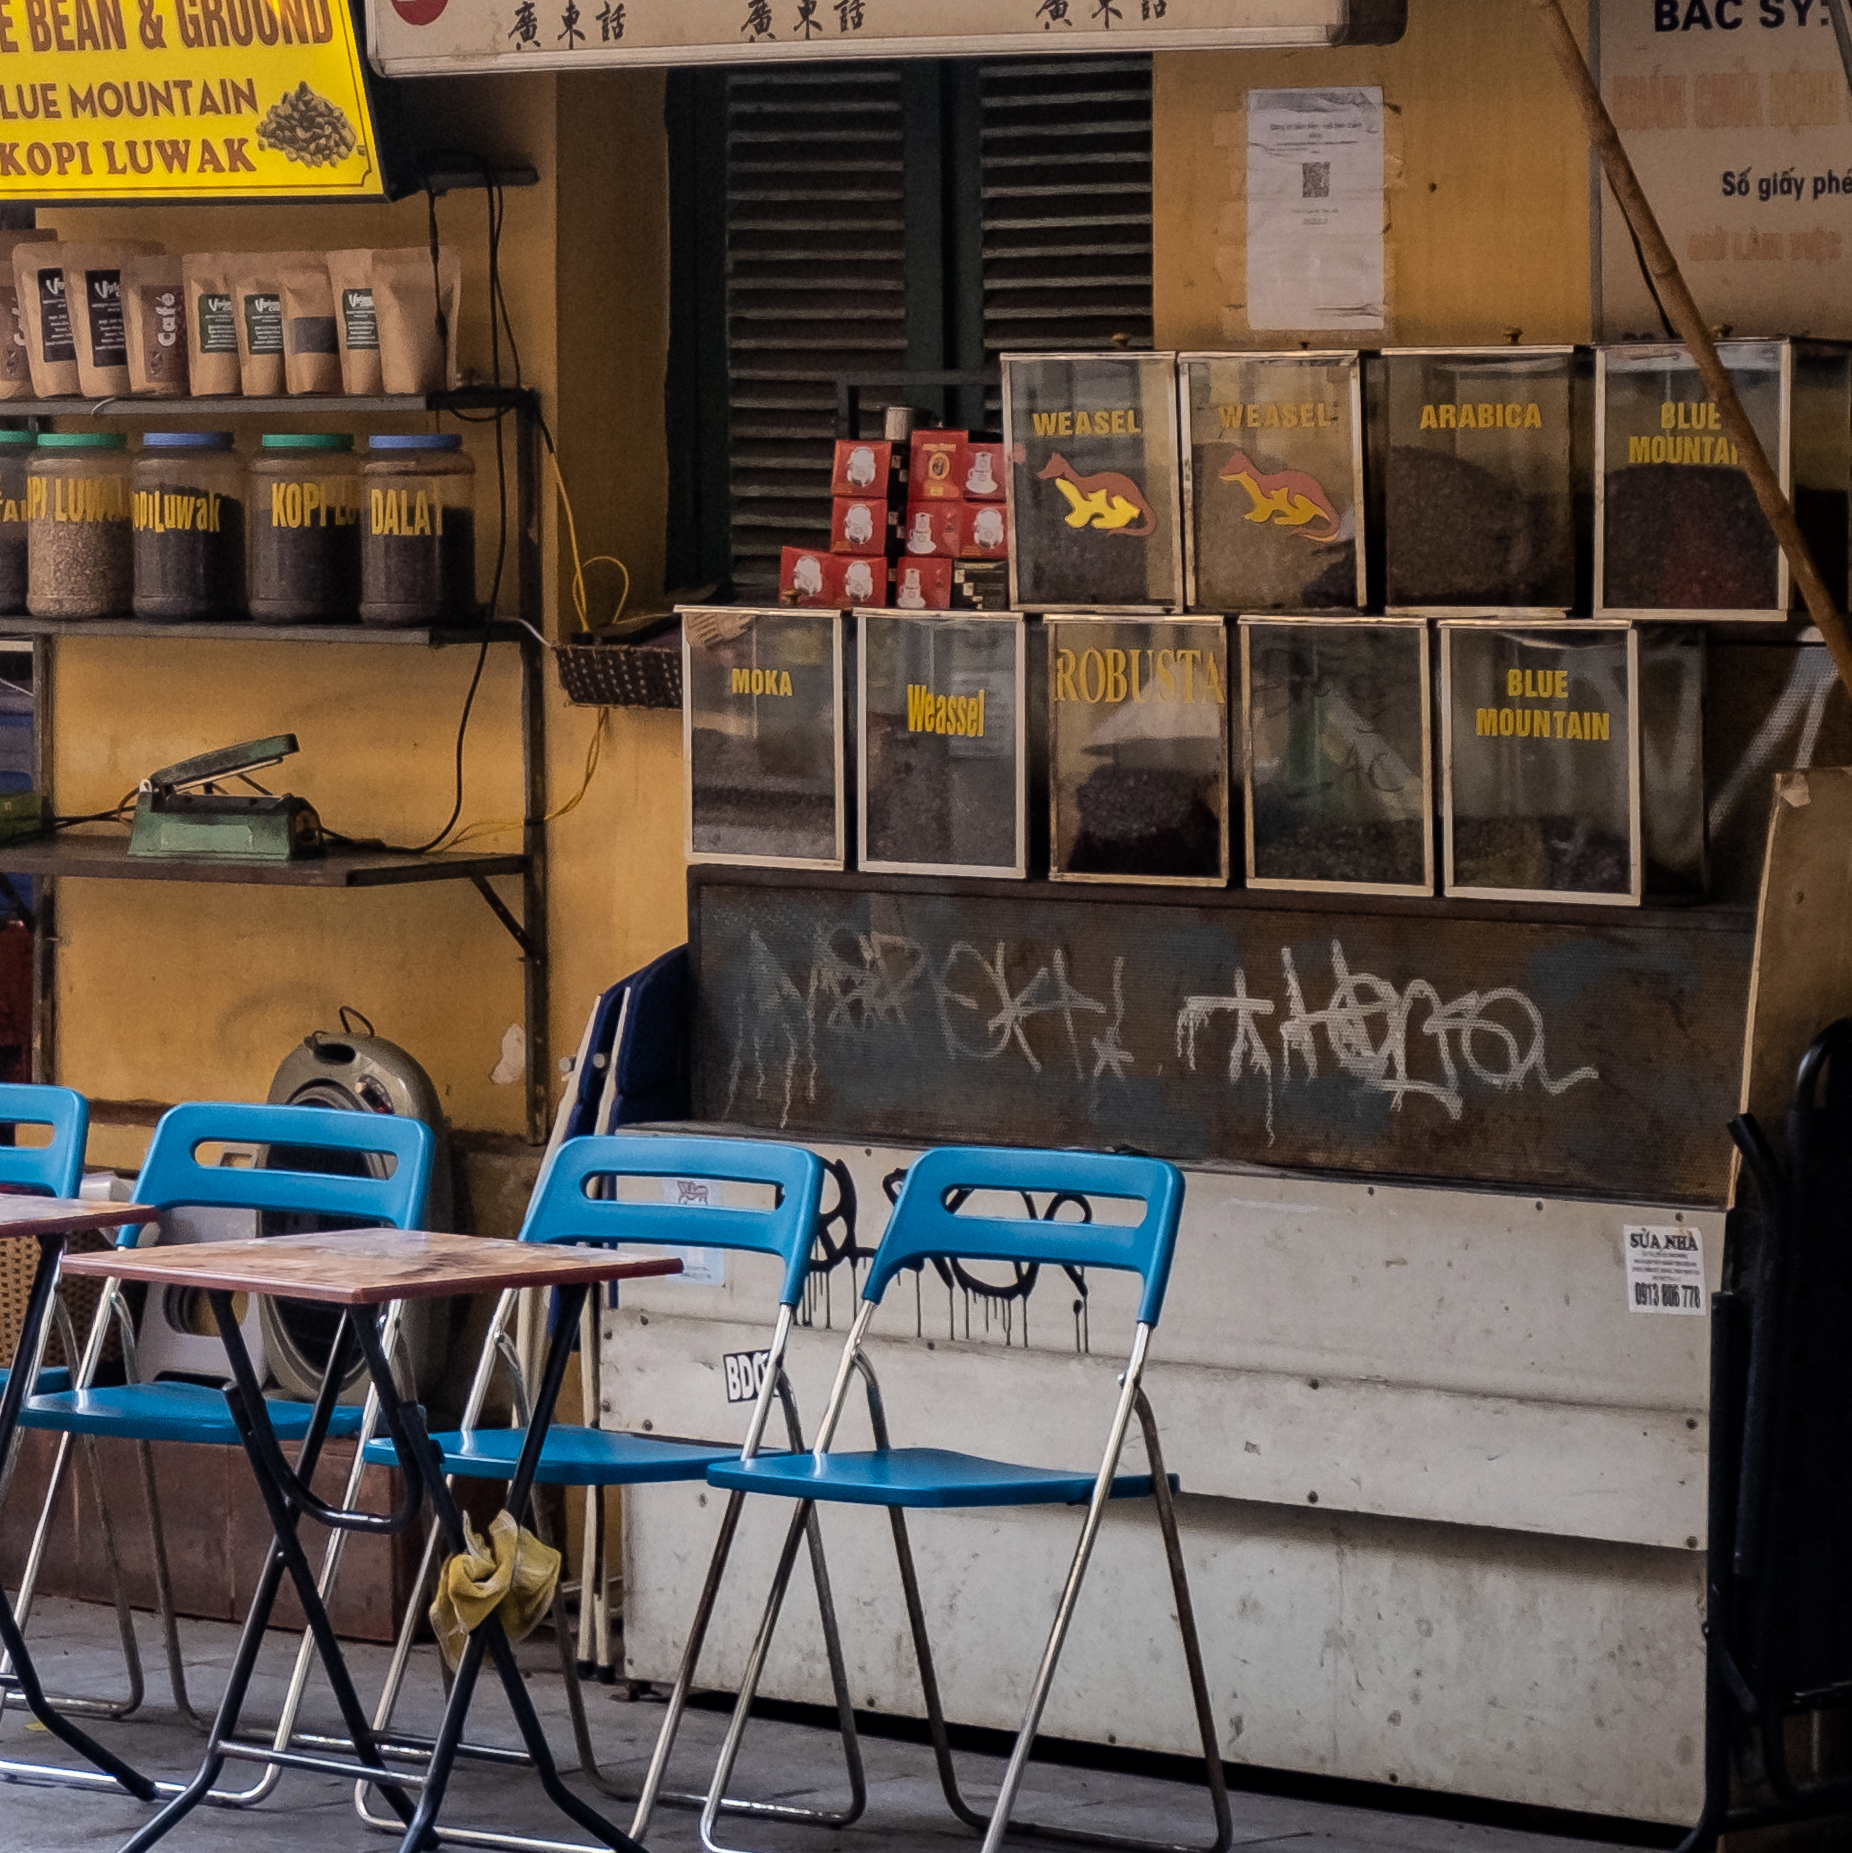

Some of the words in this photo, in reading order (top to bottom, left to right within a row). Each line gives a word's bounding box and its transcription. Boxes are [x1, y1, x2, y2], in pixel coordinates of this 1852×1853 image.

[70, 78, 260, 119] MOUNTAIN
[103, 137, 258, 175] LUWAK
[1722, 168, 1750, 198] Số
[1758, 170, 1804, 204] giấy
[1032, 409, 1142, 436] WEASEL
[1219, 402, 1331, 429] WEASEL
[1420, 403, 1543, 433] ARABICA
[1660, 401, 1722, 432] BLUE
[271, 482, 327, 527] KOPI
[730, 668, 794, 702] MOKA
[1056, 648, 1226, 705] ROBUSTA
[1507, 669, 1569, 702] BLUE
[906, 683, 986, 740] Weassel
[1476, 706, 1611, 743] MOUNTAIN
